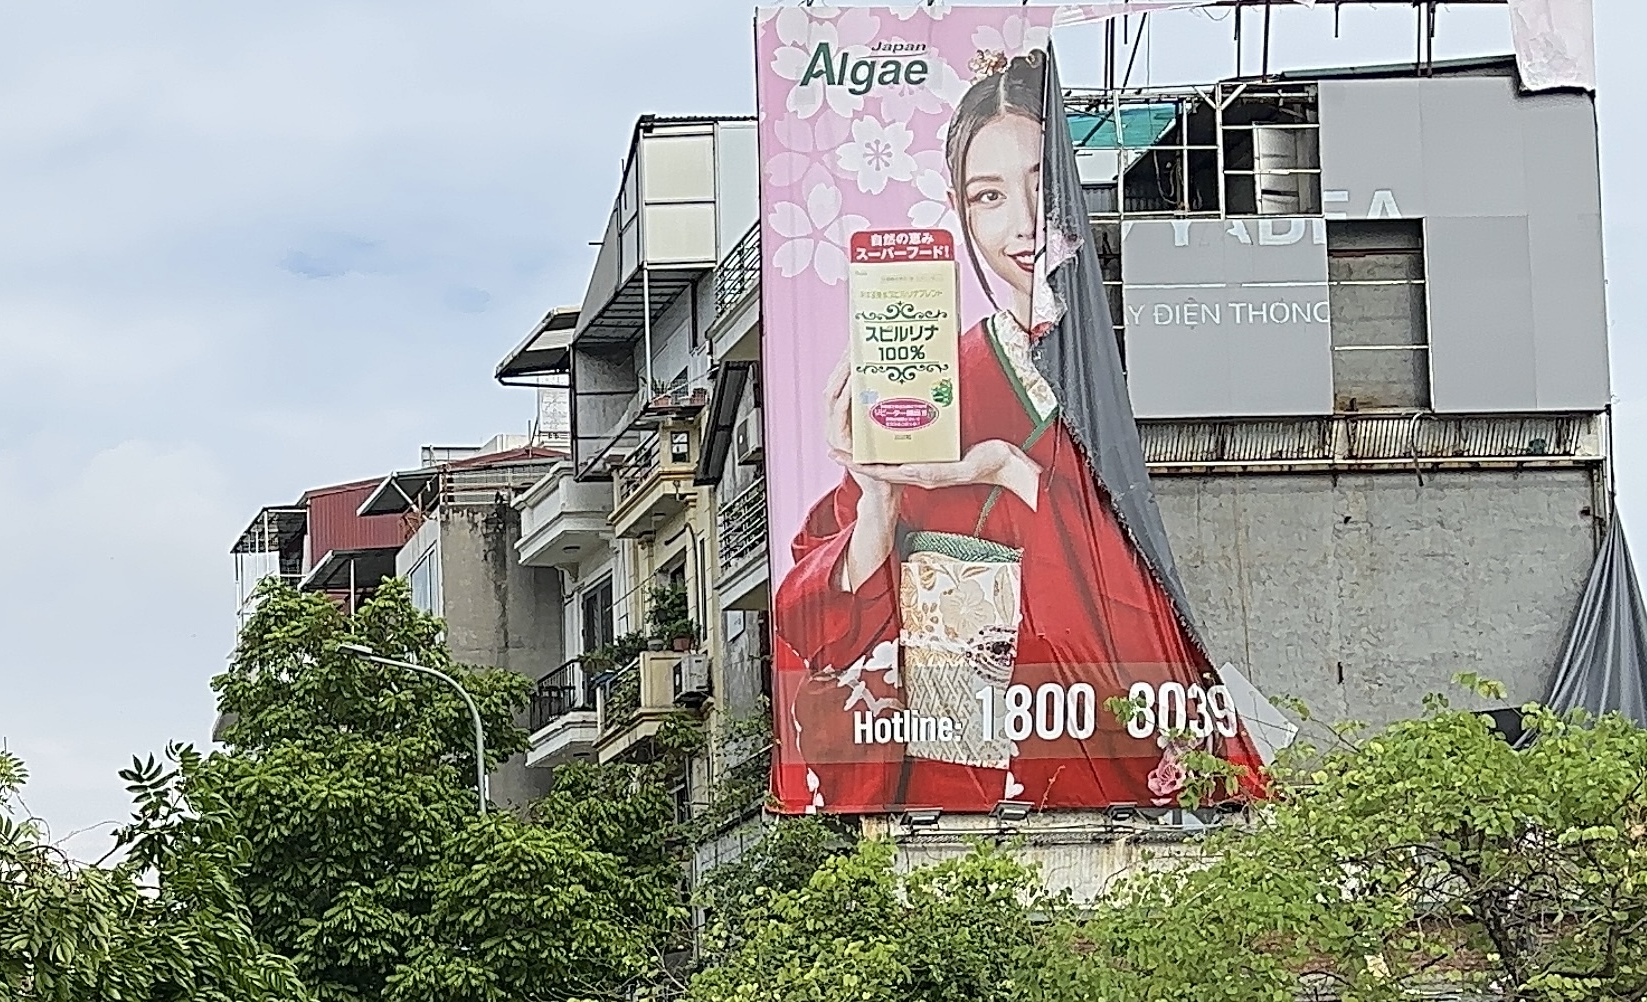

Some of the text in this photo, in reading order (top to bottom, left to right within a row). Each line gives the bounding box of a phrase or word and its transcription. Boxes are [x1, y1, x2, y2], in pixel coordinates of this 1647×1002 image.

[871, 42, 927, 53] Japan
[799, 42, 929, 95] Algae
[870, 232, 934, 246] 自然の恵み
[865, 325, 939, 342] スピルリナ
[878, 344, 925, 361] 100%
[854, 681, 1238, 744] Hotline: 1800 8039
